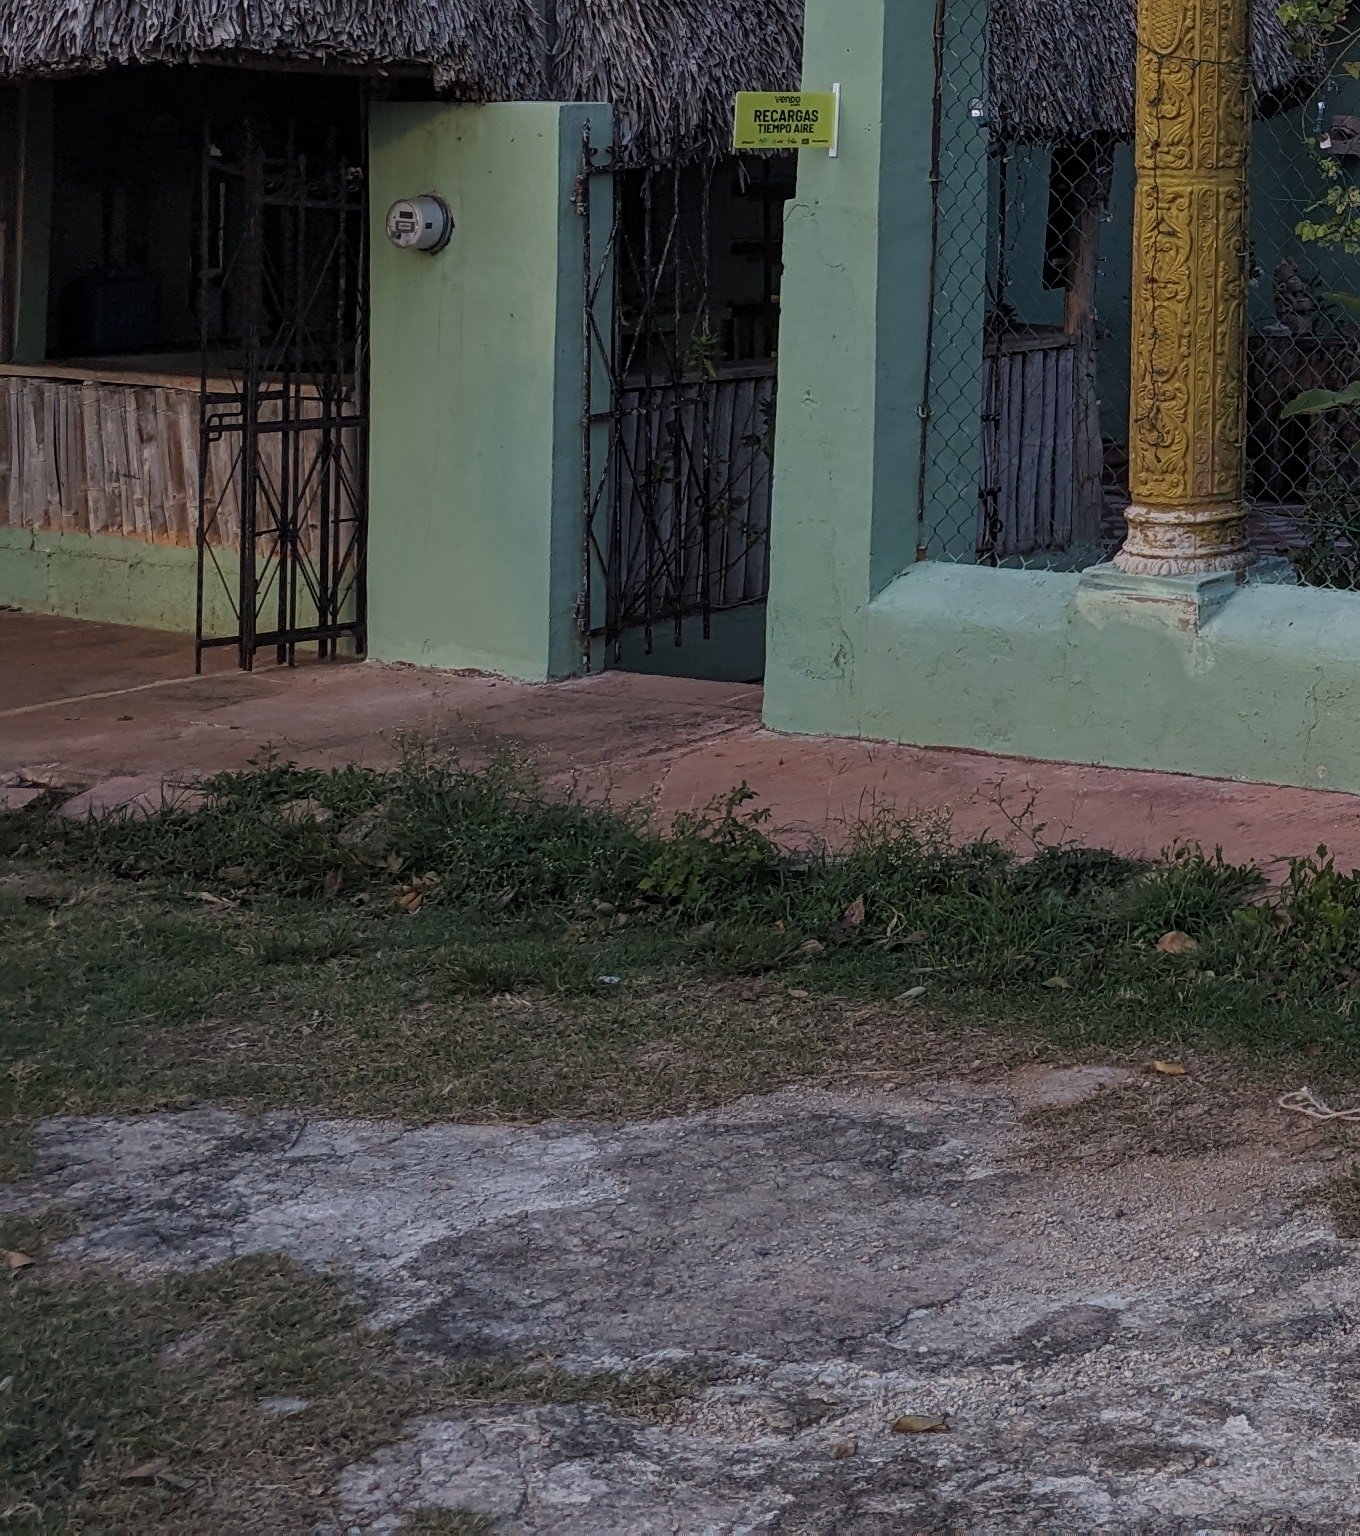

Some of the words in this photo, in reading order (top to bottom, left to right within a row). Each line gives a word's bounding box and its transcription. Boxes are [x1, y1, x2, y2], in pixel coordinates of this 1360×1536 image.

[753, 109, 819, 123] RECARGAS
[757, 124, 792, 134] TIEMPO
[793, 124, 815, 134] AIRE
